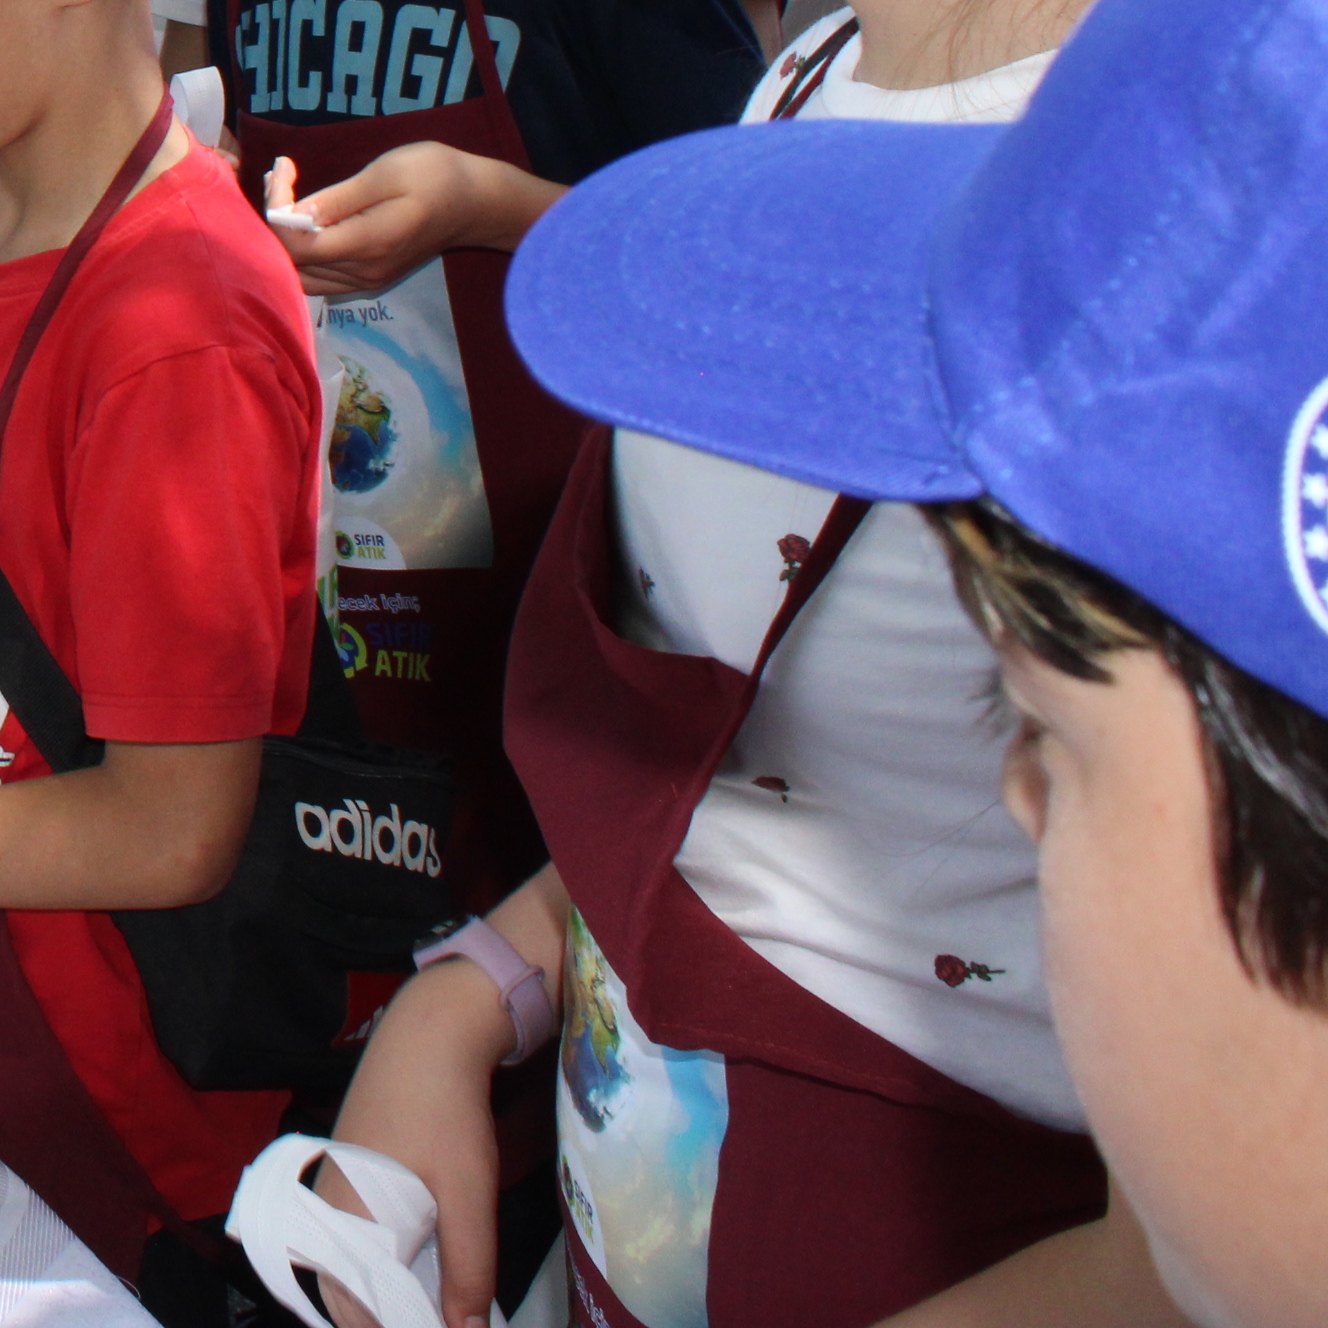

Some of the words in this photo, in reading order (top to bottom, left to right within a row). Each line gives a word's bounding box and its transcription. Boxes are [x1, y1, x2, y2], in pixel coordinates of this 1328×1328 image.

[358, 300, 394, 327] yok.
[354, 533, 385, 547] SIFIR
[357, 546, 386, 560] ATIK
[366, 622, 434, 650] SIFIR
[374, 648, 432, 683] ATIK
[294, 798, 442, 878] adidas
